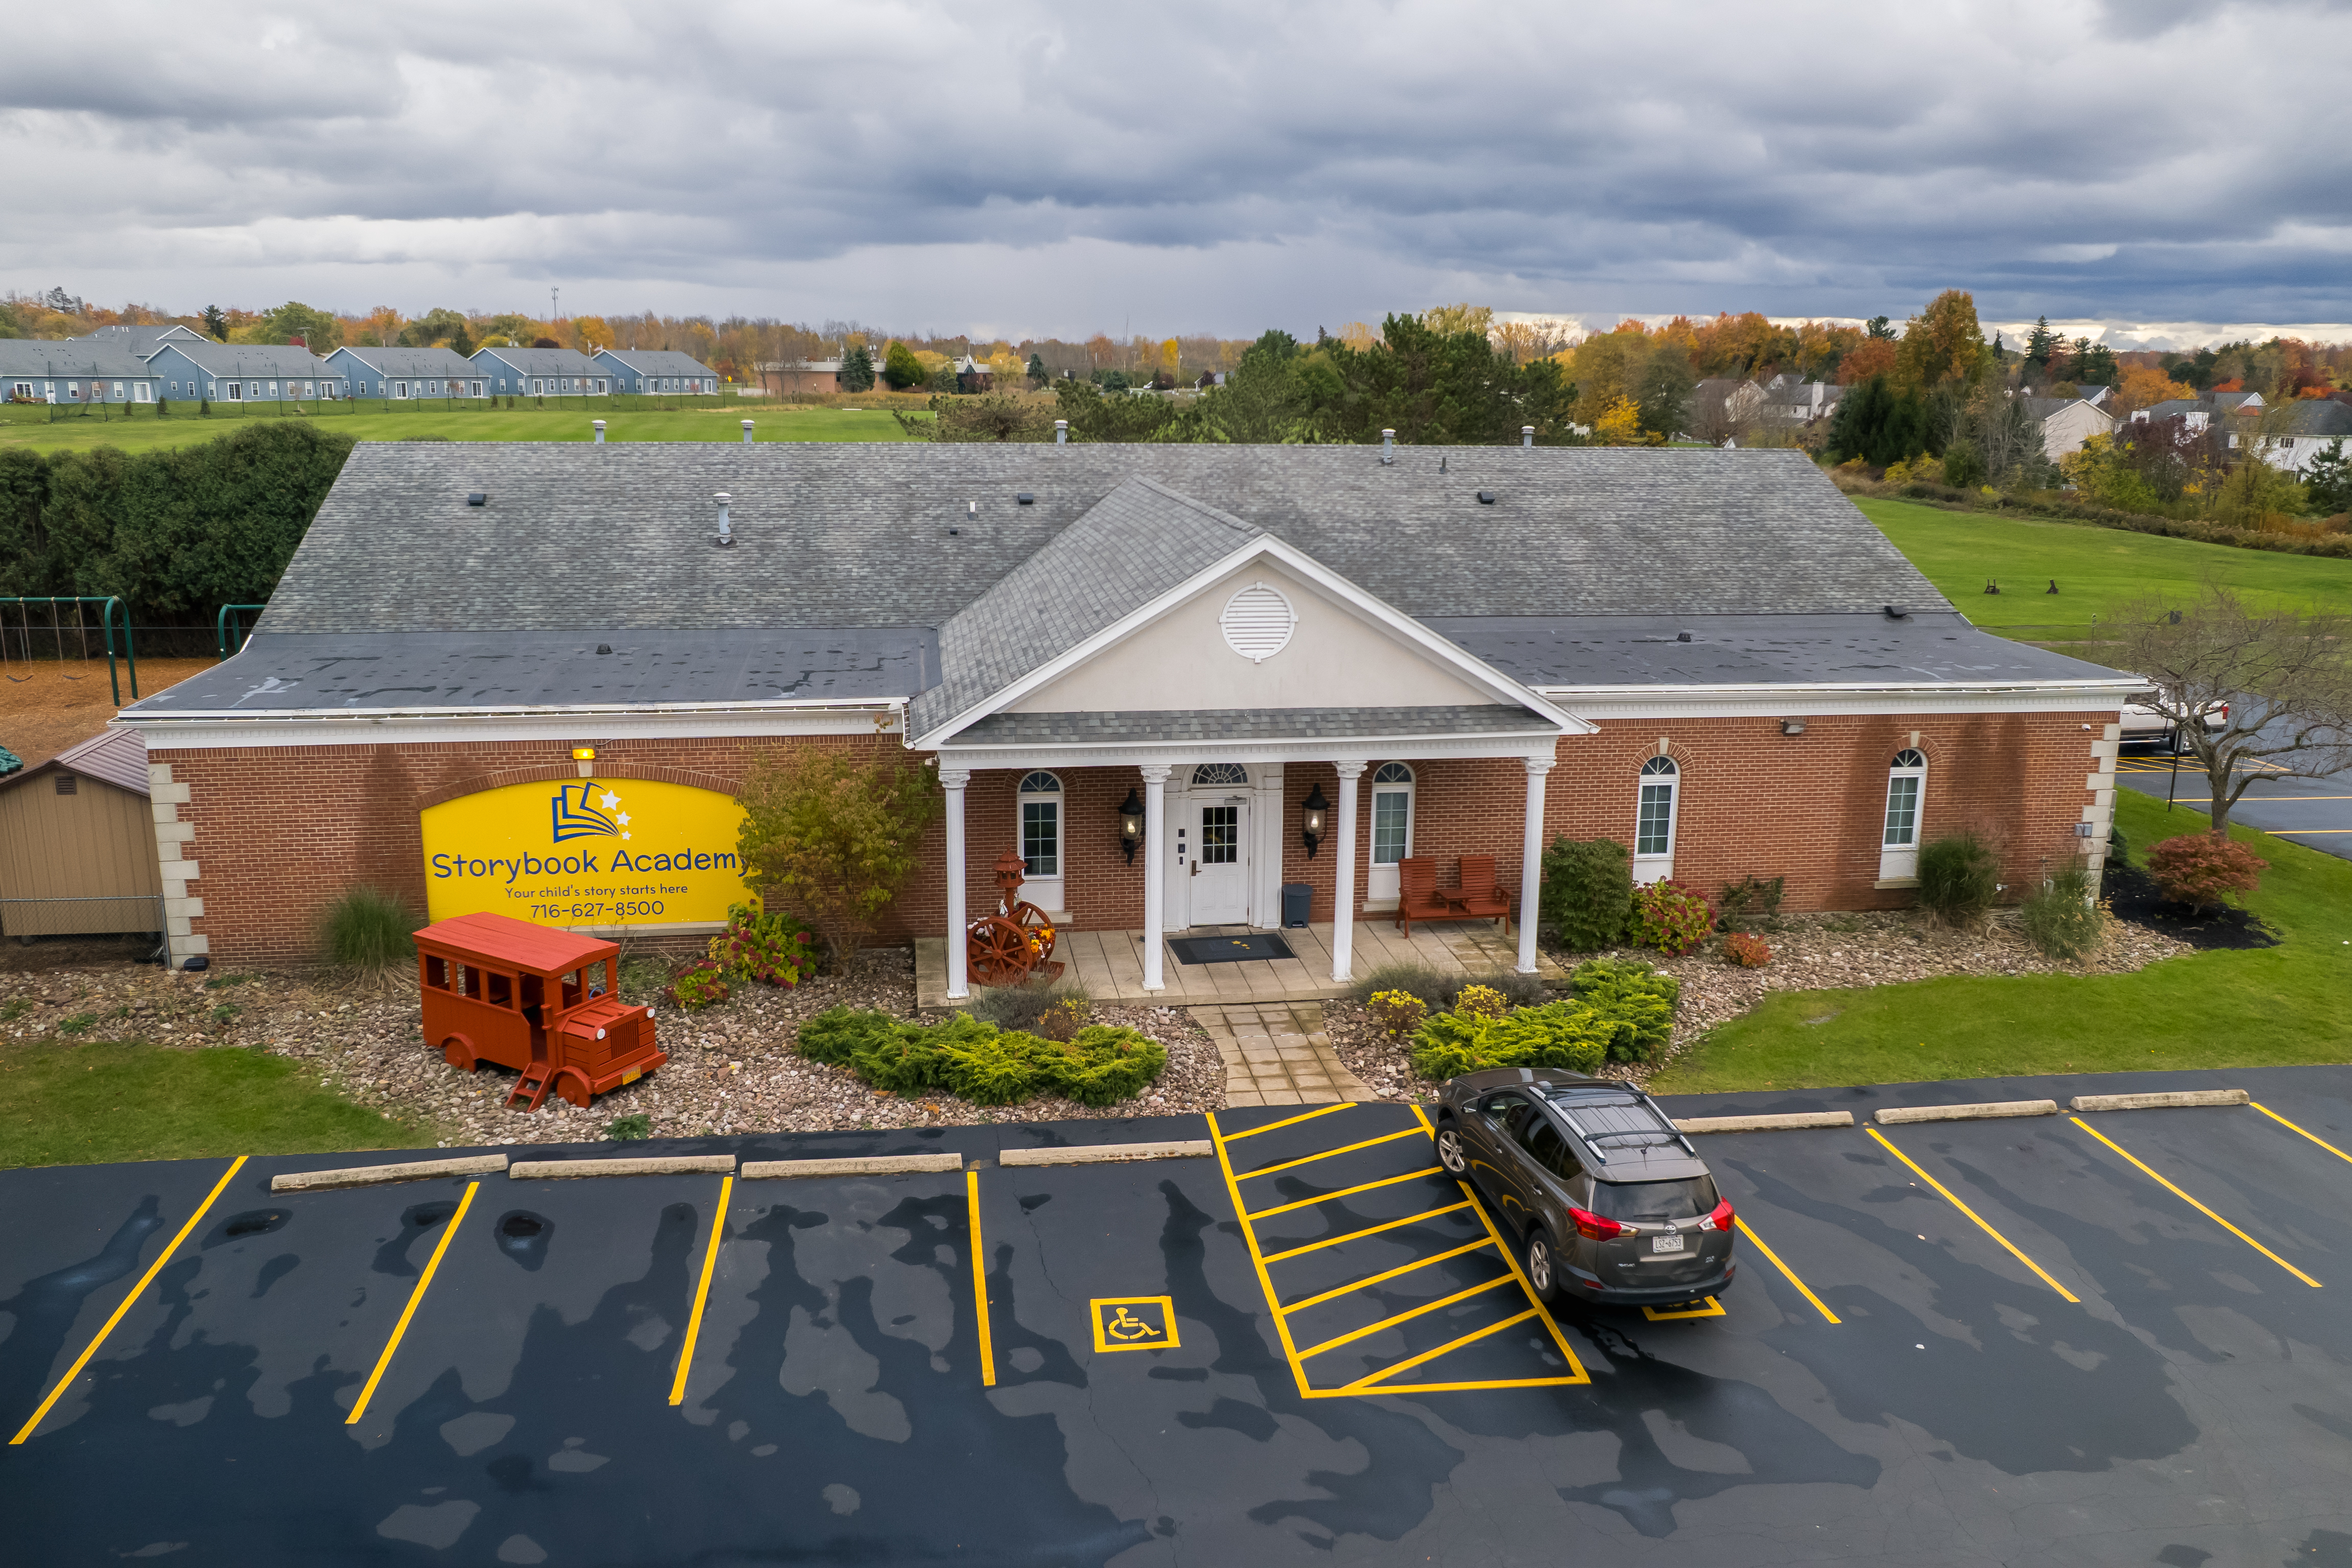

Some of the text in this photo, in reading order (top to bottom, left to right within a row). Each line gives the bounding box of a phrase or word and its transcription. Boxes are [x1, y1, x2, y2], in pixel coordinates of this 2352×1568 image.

[432, 849, 599, 885] Storybook
[505, 883, 688, 899] Your child's story starts here
[531, 900, 664, 918] 716-627-8500
